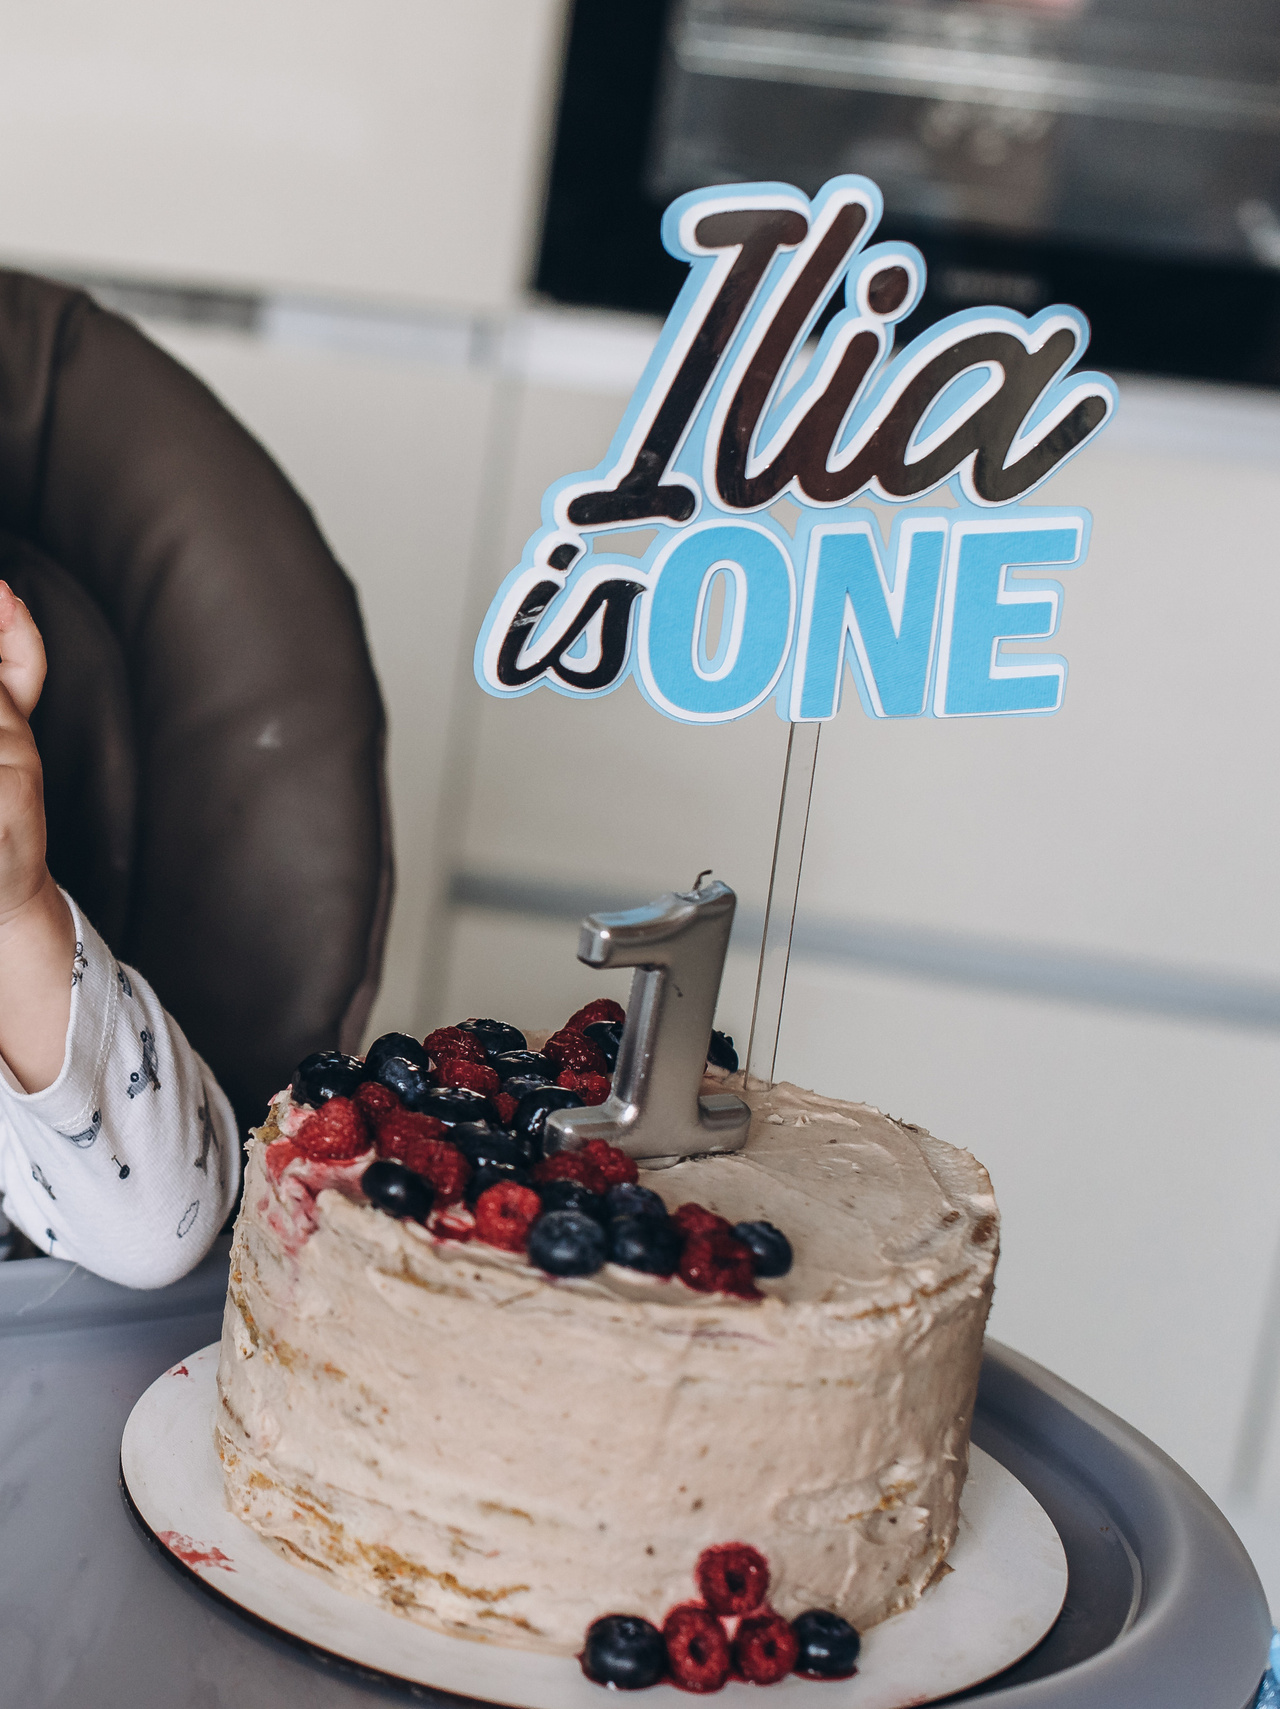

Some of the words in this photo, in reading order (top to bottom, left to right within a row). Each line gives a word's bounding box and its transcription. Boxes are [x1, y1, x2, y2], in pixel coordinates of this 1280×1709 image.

[567, 201, 1107, 525] Ilia
[497, 543, 647, 690] is
[647, 525, 1079, 718] ONE
[543, 880, 752, 1170] 1
